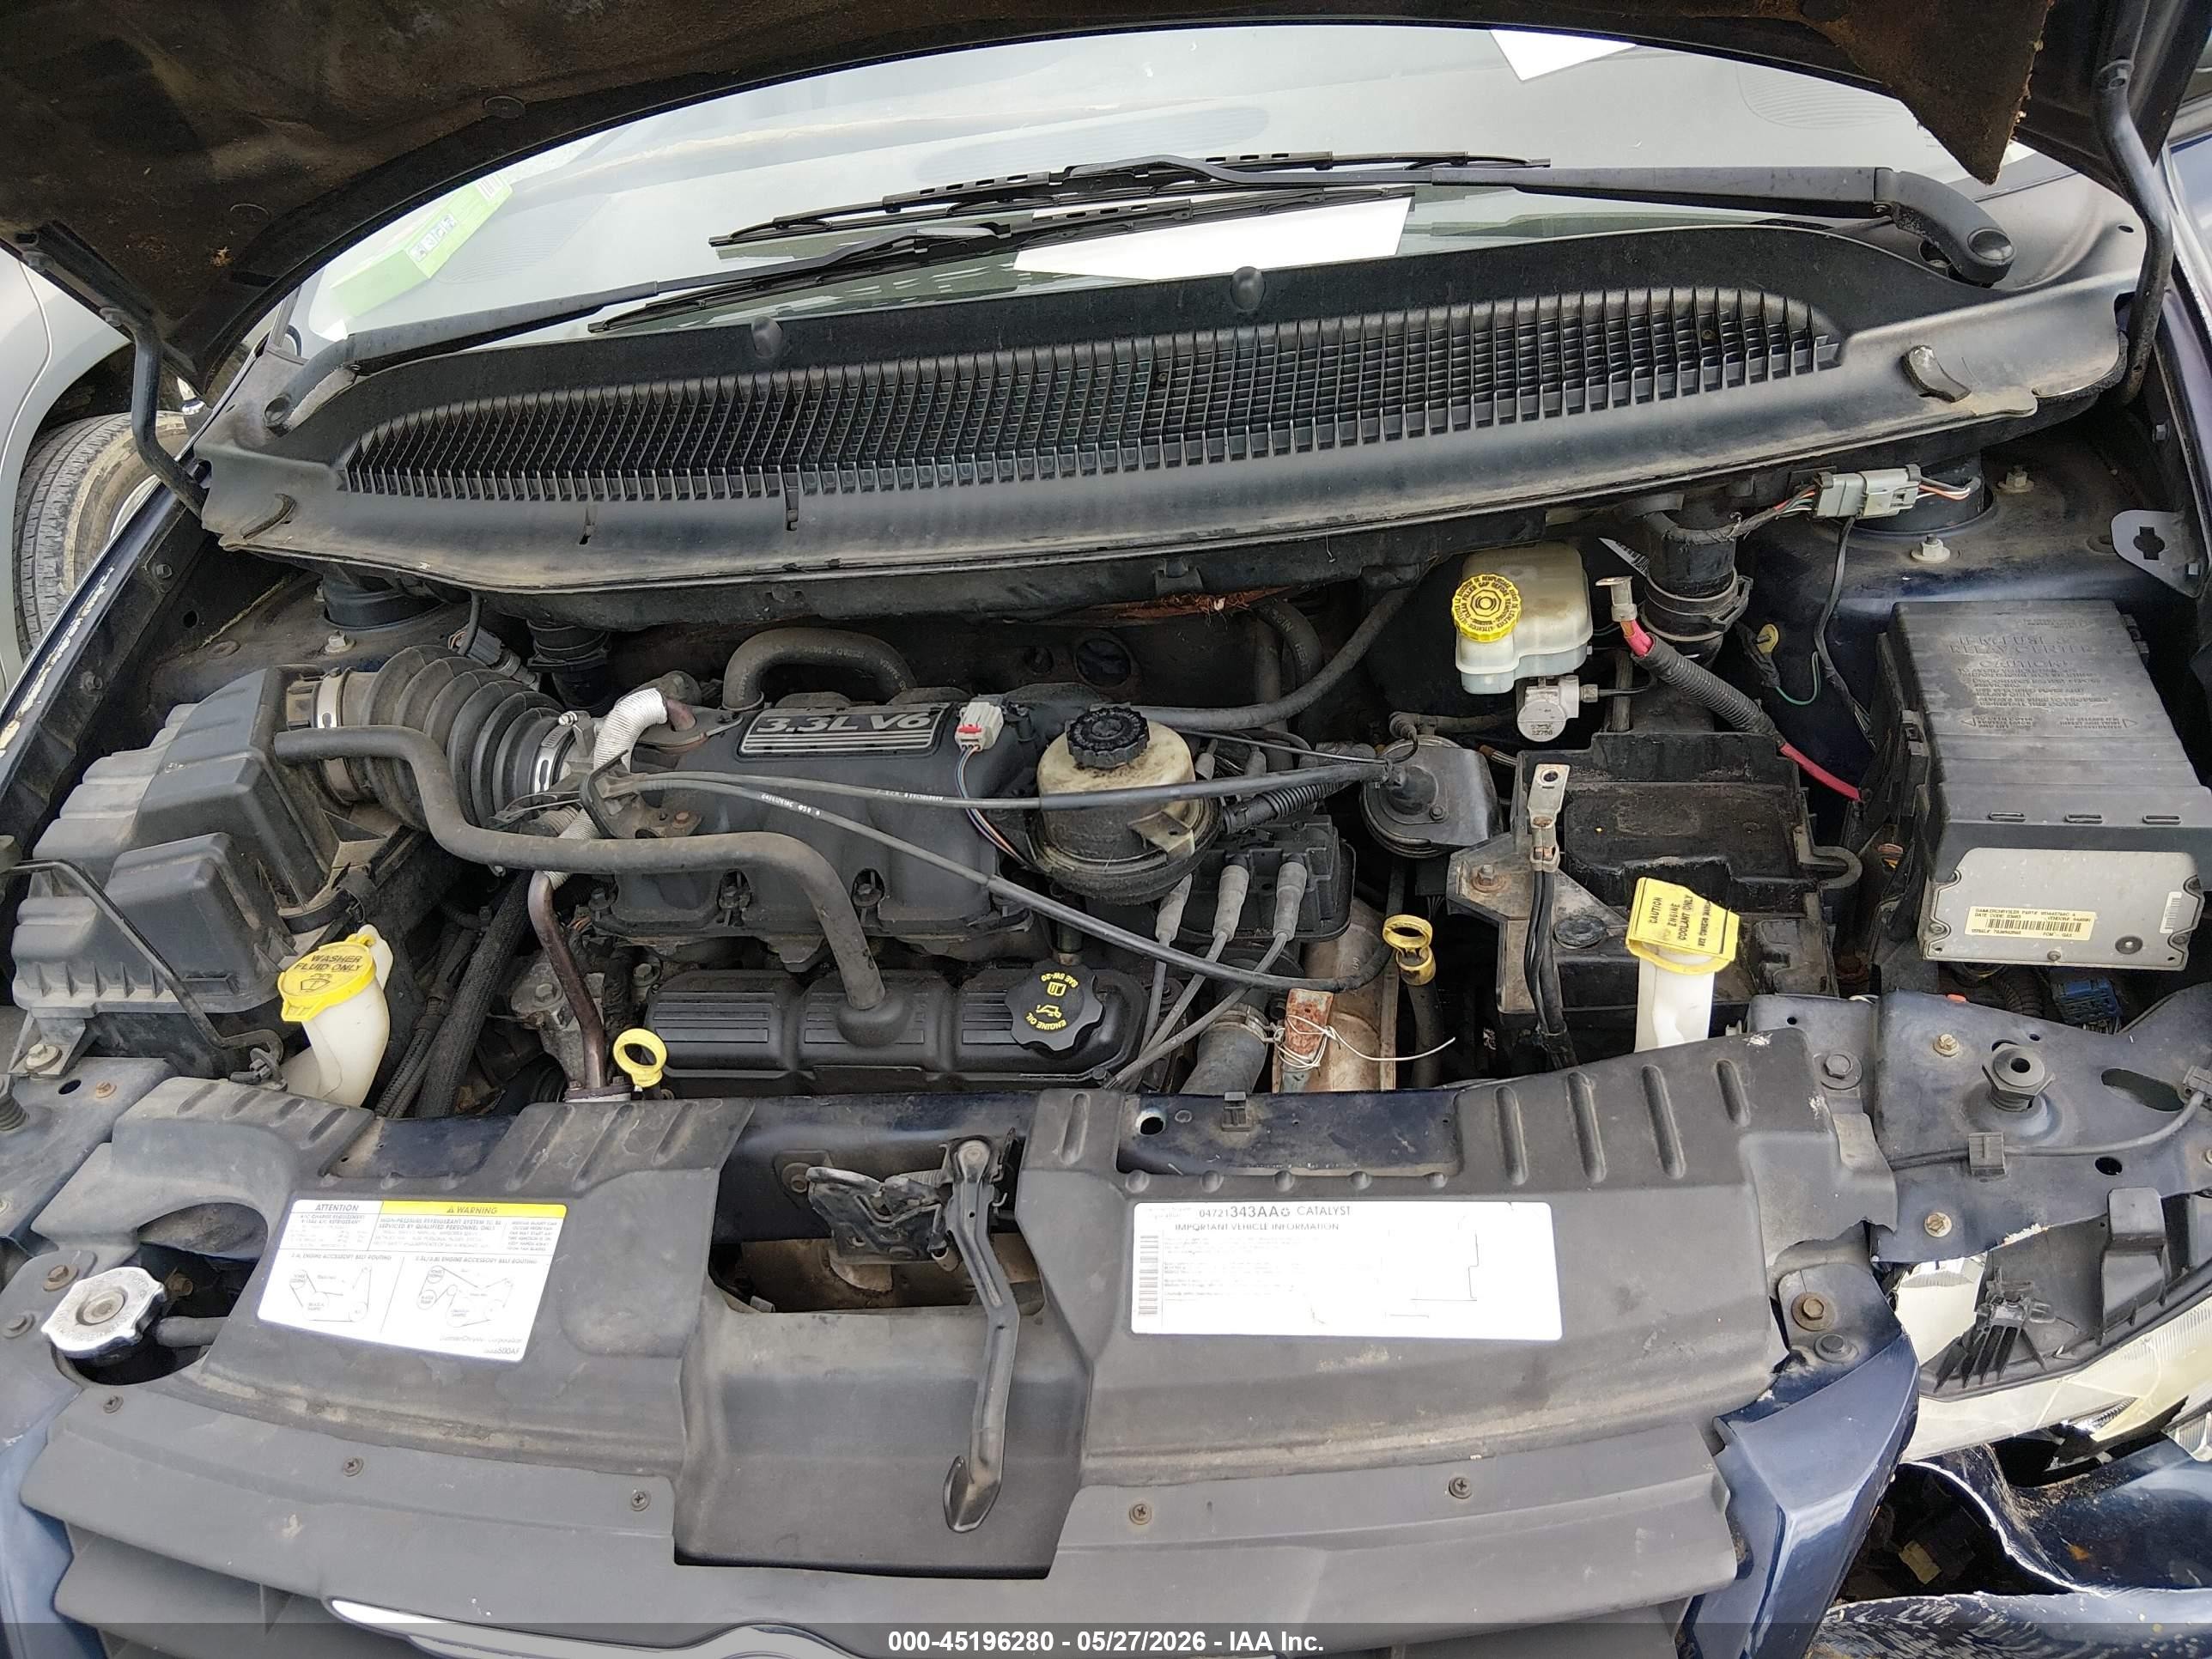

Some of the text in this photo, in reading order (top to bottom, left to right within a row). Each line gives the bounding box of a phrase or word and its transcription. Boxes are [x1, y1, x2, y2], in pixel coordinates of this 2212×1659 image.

[756, 712, 932, 733] 3.3L V6
[1648, 896, 1662, 924] CAUTION
[1667, 902, 1680, 927] ENGINE
[1678, 894, 1694, 941] COOLANT ONLY
[311, 954, 362, 963] WASHER
[294, 962, 364, 972] FLUID ONLY
[1064, 975, 1079, 988] SAE
[1025, 1012, 1067, 1030] ENGINE OIL
[315, 1203, 359, 1212] ATTENTION
[457, 1206, 498, 1214] WARNING
[1297, 1206, 1351, 1217] CATALYST
[1175, 1223, 1229, 1231] IMPORTANT
[1272, 1222, 1340, 1231] INFORMATION
